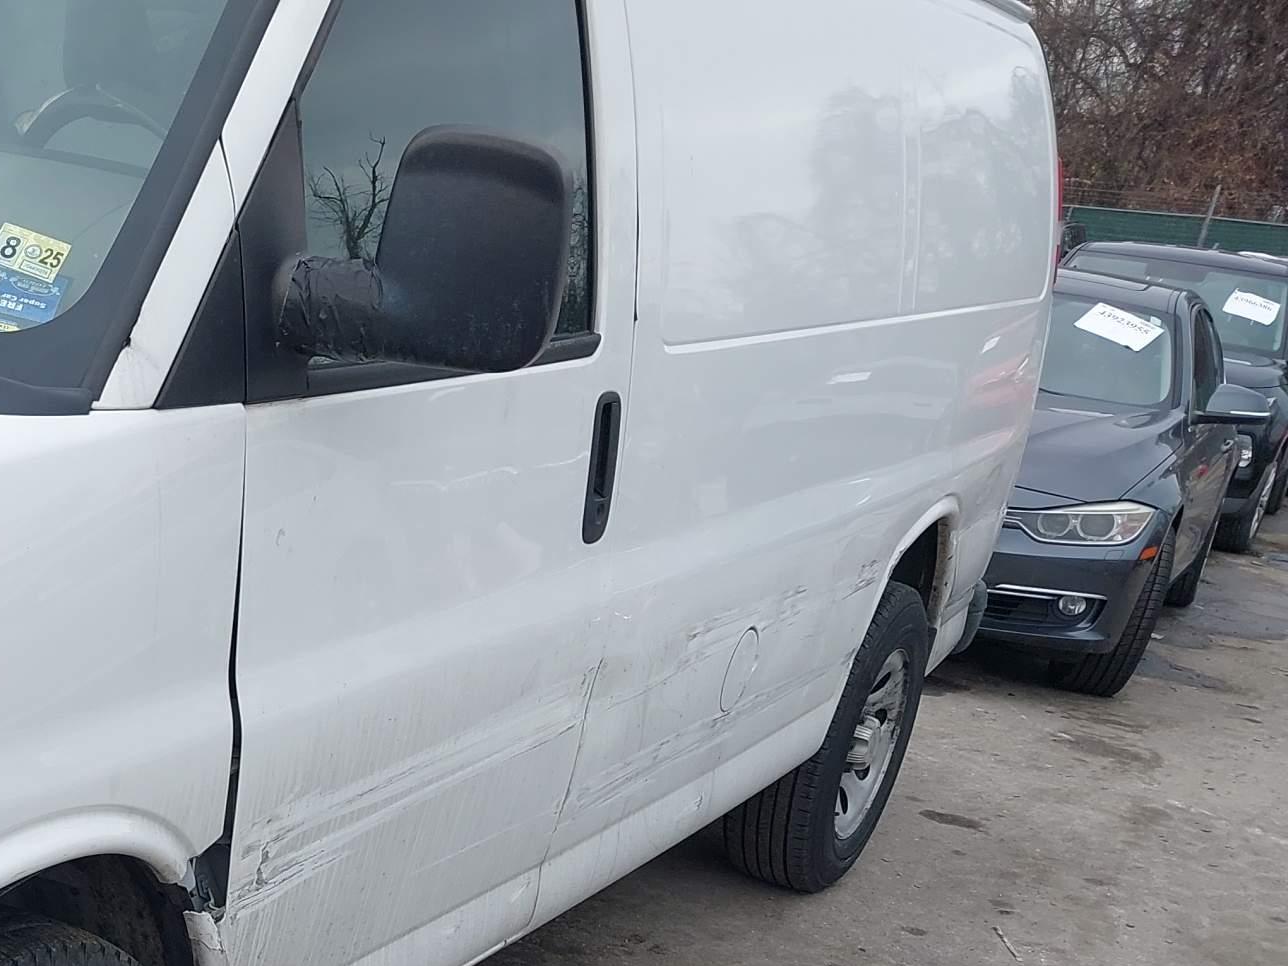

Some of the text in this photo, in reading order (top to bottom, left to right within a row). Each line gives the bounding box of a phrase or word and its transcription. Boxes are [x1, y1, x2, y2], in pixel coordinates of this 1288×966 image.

[0, 236, 64, 268] 8 25
[2, 293, 19, 302] Car
[19, 298, 47, 309] Super
